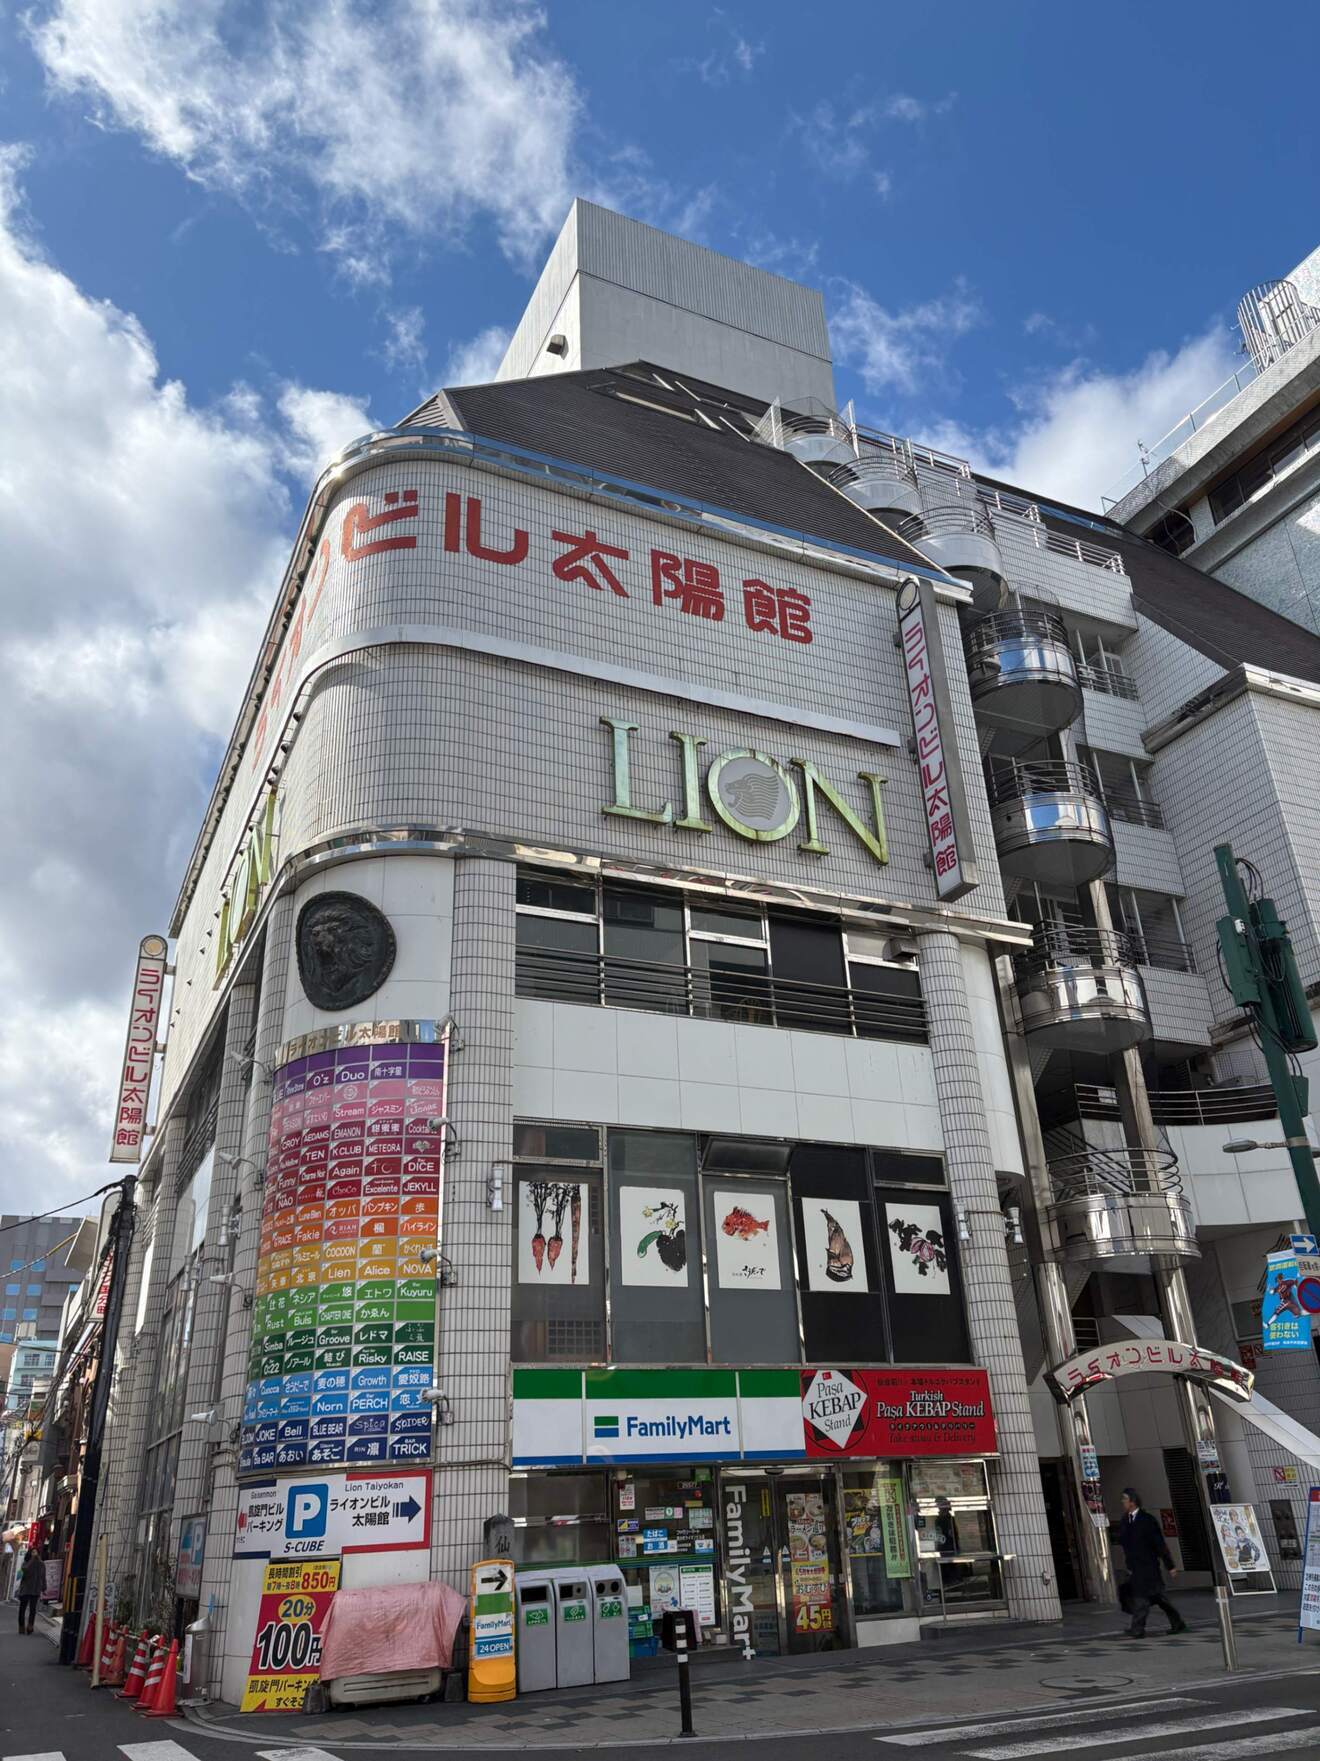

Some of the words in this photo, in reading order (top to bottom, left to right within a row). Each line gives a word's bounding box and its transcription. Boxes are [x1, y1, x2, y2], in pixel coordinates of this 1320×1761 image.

[904, 621, 957, 877] ライオンビル太陽館
[600, 715, 889, 866] LION
[116, 968, 160, 1147] ライオンビル太陽館
[341, 1071, 365, 1081] Duo
[335, 1106, 364, 1118] Stream
[368, 1143, 400, 1154] METEORA
[305, 1150, 325, 1161] TEN
[333, 1166, 360, 1177] Again
[408, 1162, 434, 1171] DICE
[404, 1182, 436, 1192] JEKYLL
[403, 1222, 437, 1232] ハイライン
[297, 1231, 320, 1242] Fakie
[328, 1268, 350, 1279] Lien
[365, 1265, 390, 1275] Alice
[403, 1263, 432, 1274] NOVA
[400, 1286, 432, 1298] Kuyuru
[319, 1334, 350, 1345] Groove
[359, 1353, 387, 1364] Risky
[398, 1351, 429, 1362] RAISE
[358, 1375, 386, 1386] Growth
[910, 1390, 944, 1401] Turkish
[317, 1402, 343, 1412] Norn
[352, 1398, 388, 1410] PERCH
[809, 1392, 861, 1420] KEBAP
[906, 1402, 951, 1417] KEBAP
[952, 1401, 984, 1417] Stand
[626, 1415, 731, 1439] FamilyMart
[824, 1414, 852, 1432] Stand
[256, 1429, 275, 1442] JOKE
[285, 1425, 302, 1436] Bell
[393, 1443, 426, 1454] TRICK
[345, 1483, 363, 1492] Lion
[365, 1481, 404, 1492] Taiyokan
[330, 1495, 391, 1512] ライオンビル
[293, 1493, 321, 1531] P
[352, 1512, 390, 1527] 太陽館
[247, 1518, 284, 1533] パーキング
[283, 1540, 325, 1553] S-CUBE
[725, 1485, 757, 1661] FamilyMart
[282, 1599, 315, 1618] 20分
